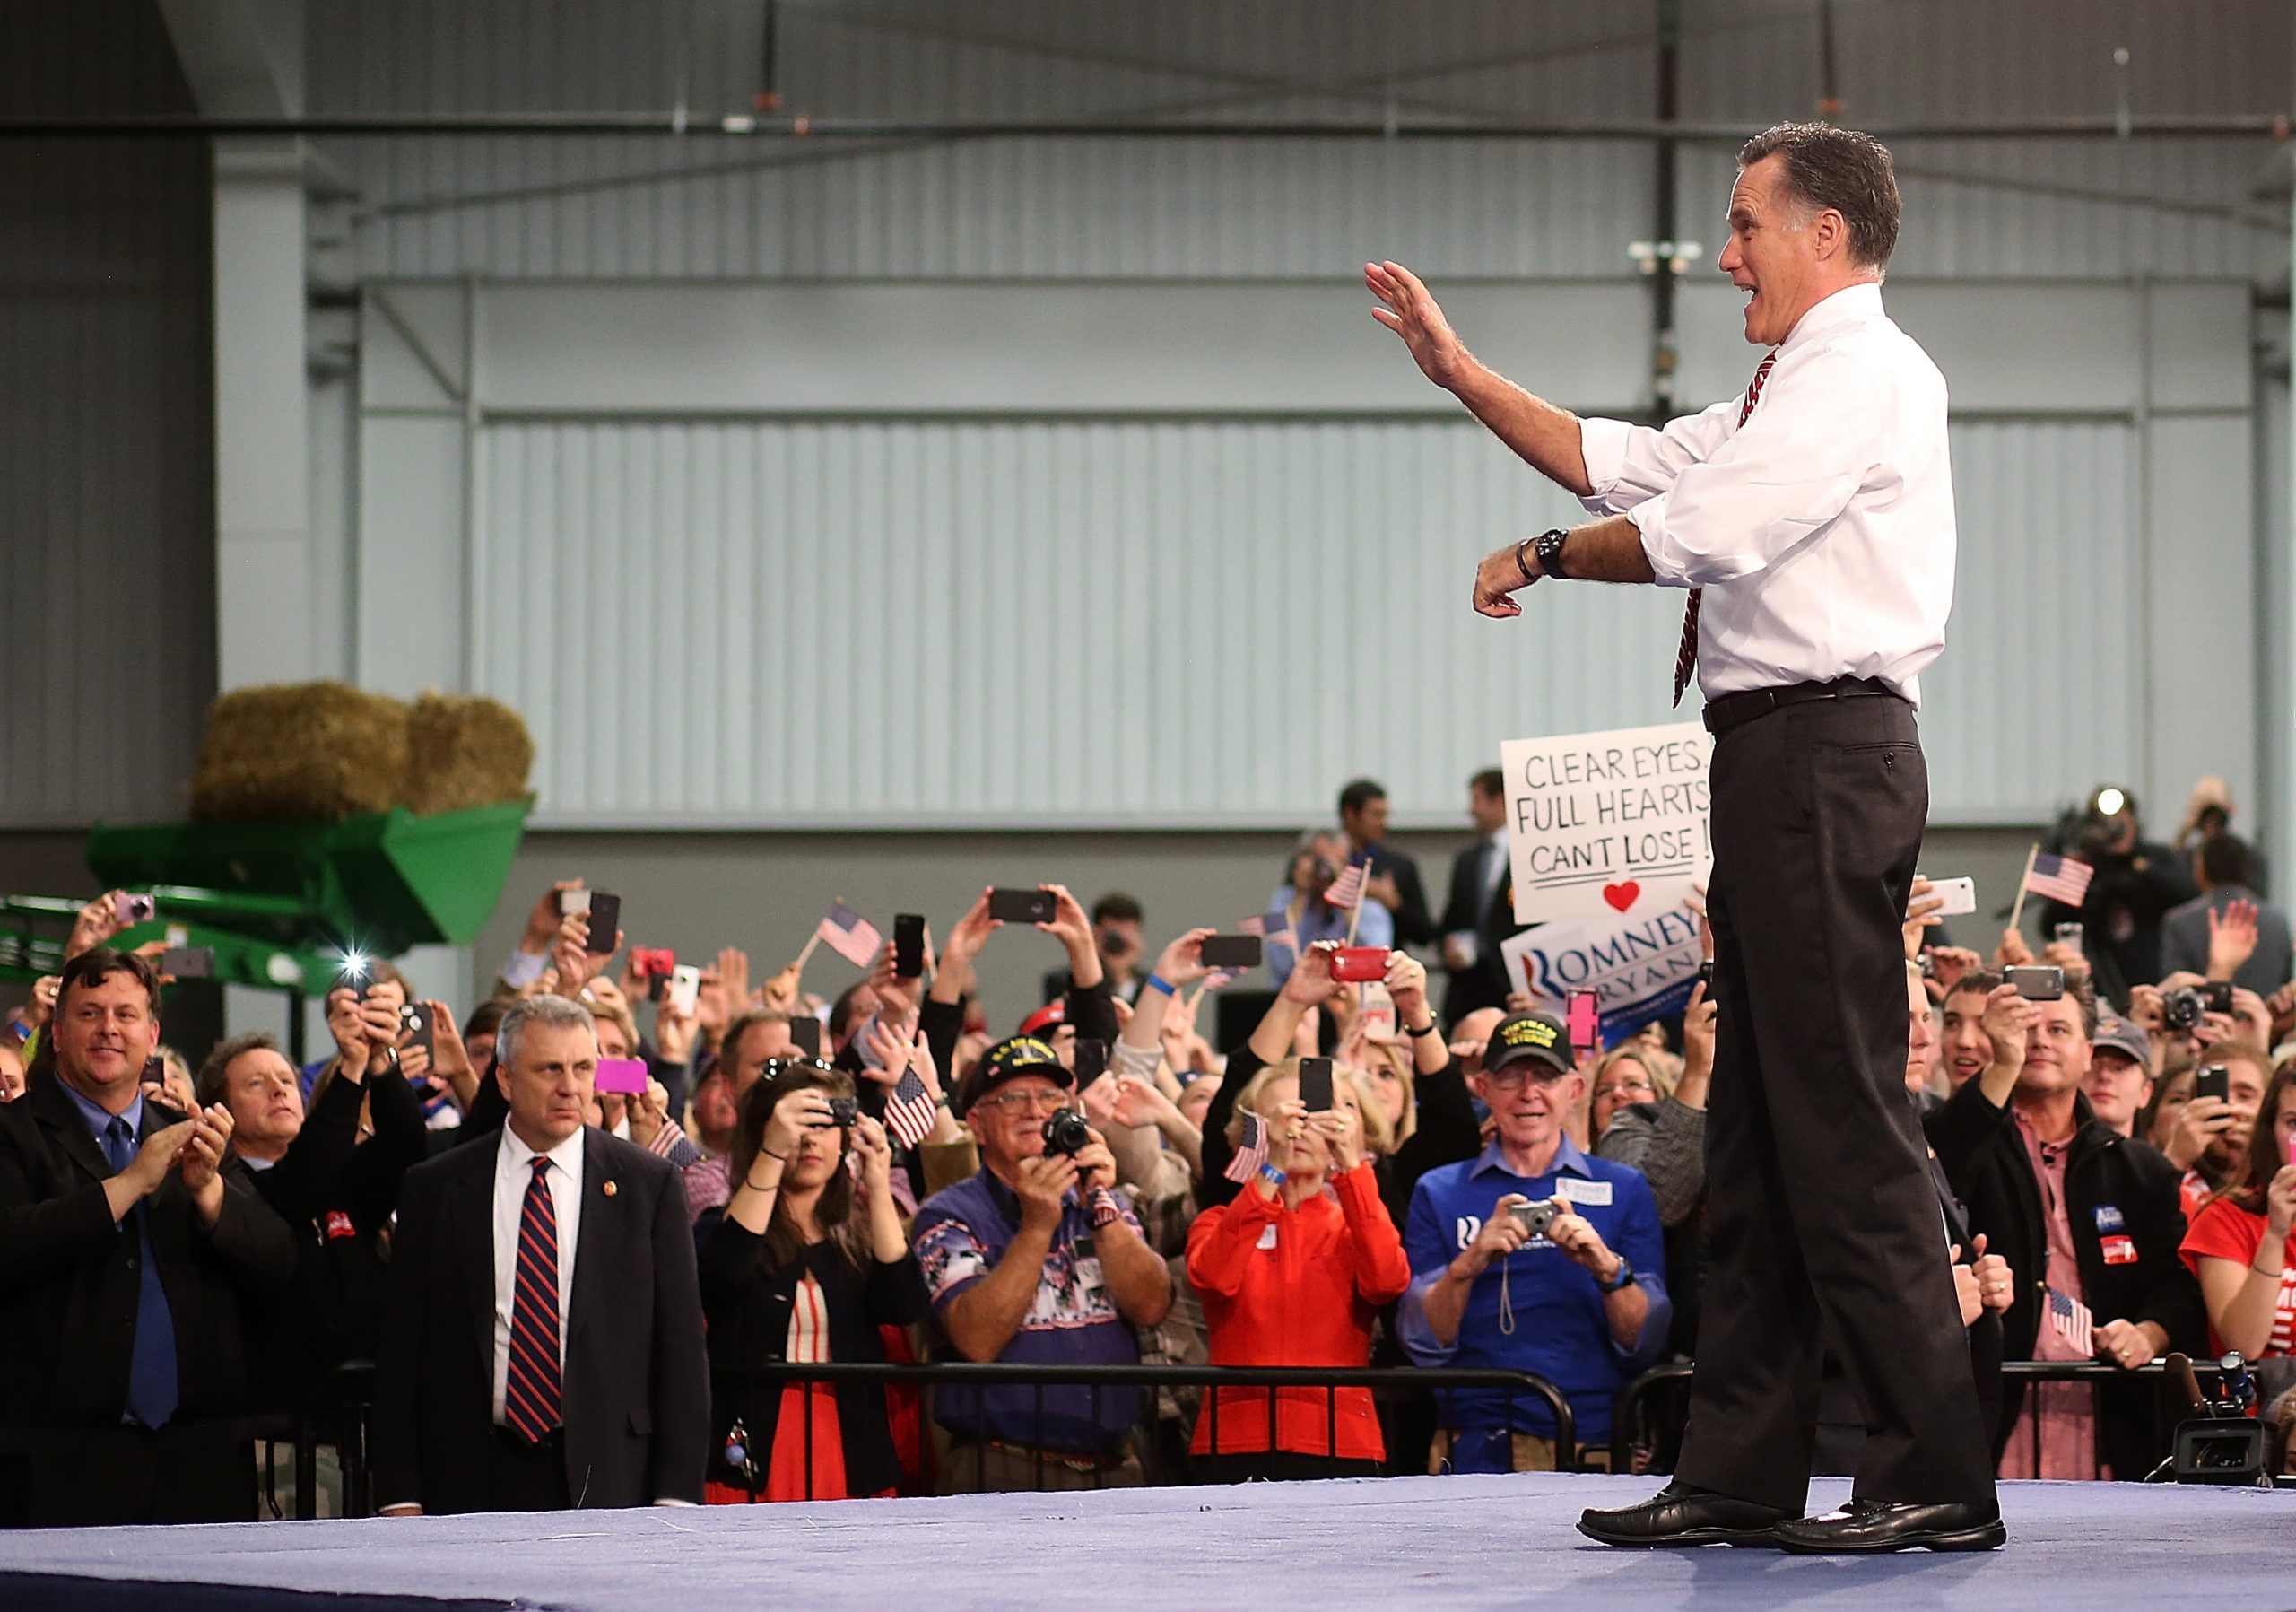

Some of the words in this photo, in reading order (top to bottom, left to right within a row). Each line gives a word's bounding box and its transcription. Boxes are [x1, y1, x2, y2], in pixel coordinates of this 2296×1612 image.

[1525, 748, 1627, 789] CLEAR
[1516, 794, 1587, 834] FULL
[1596, 780, 1710, 825] HEARTS
[1520, 907, 1699, 999] ROMNEY
[1597, 950, 1696, 1002] RYAN
